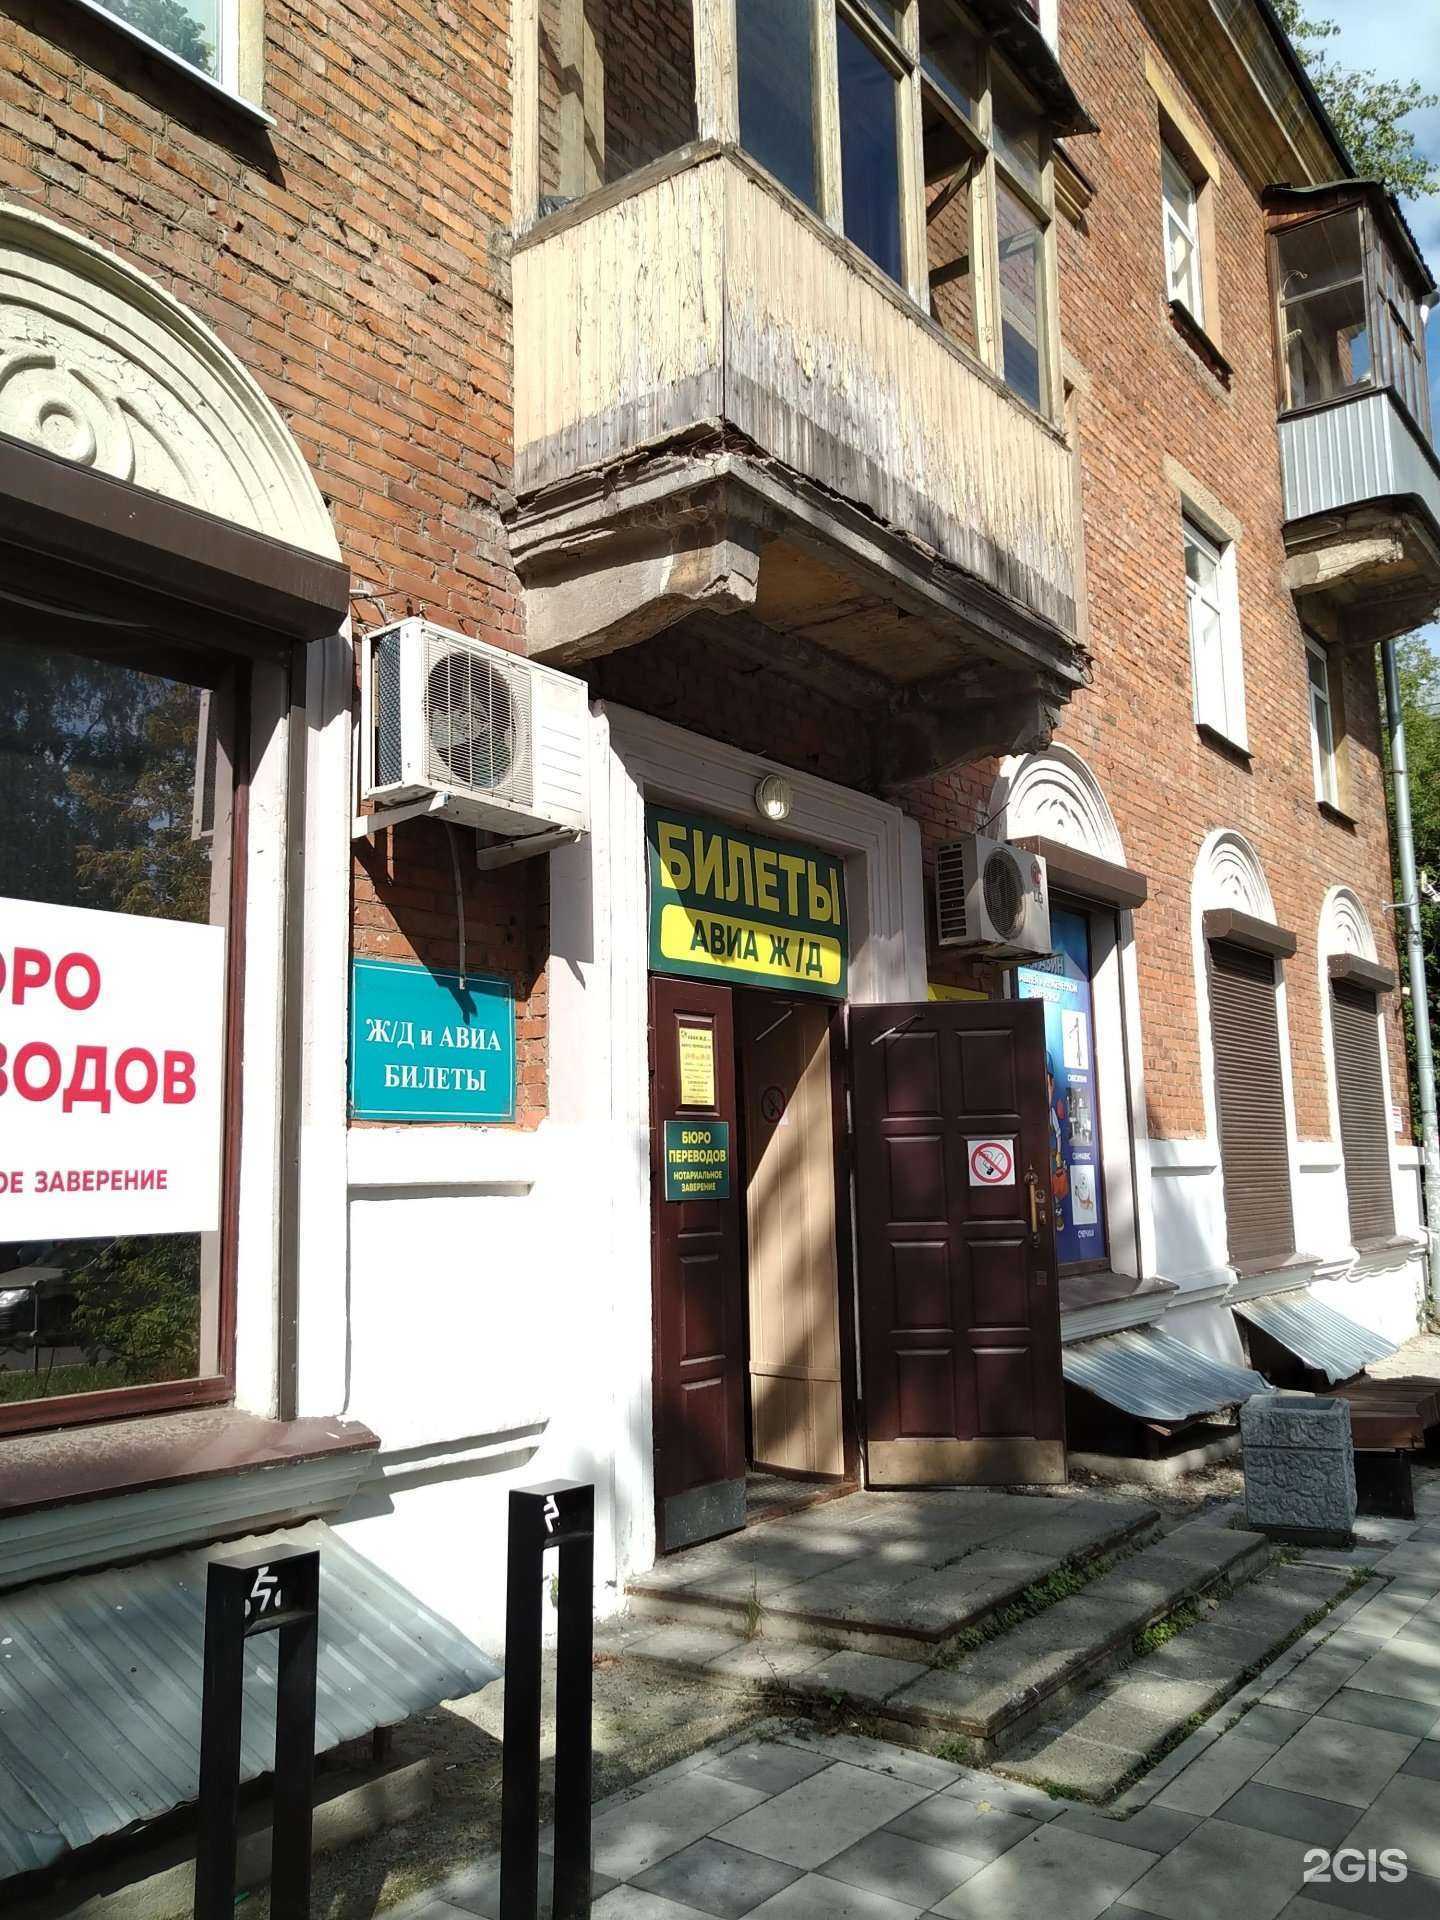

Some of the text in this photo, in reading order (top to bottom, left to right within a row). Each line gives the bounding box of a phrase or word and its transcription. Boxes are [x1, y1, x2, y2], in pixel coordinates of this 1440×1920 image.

[657, 820, 841, 925] БИЛЕТЫ
[690, 919, 759, 962] АВИА
[0, 946, 101, 1011] РО
[366, 1018, 502, 1051] Ж/Д и АВИА
[0, 1041, 197, 1114] ОДОВ
[384, 1064, 487, 1092] БИЛЕТЫ
[682, 1131, 711, 1144] БЮРО
[669, 1149, 726, 1164] ПЕРЕВОДОВ
[34, 1169, 168, 1193] ЗАВЕРЕНИЕ
[673, 1171, 722, 1180] НОТАРИАЛЬНОЕ
[681, 1182, 716, 1192] ЗАВЕРЕНИЕ
